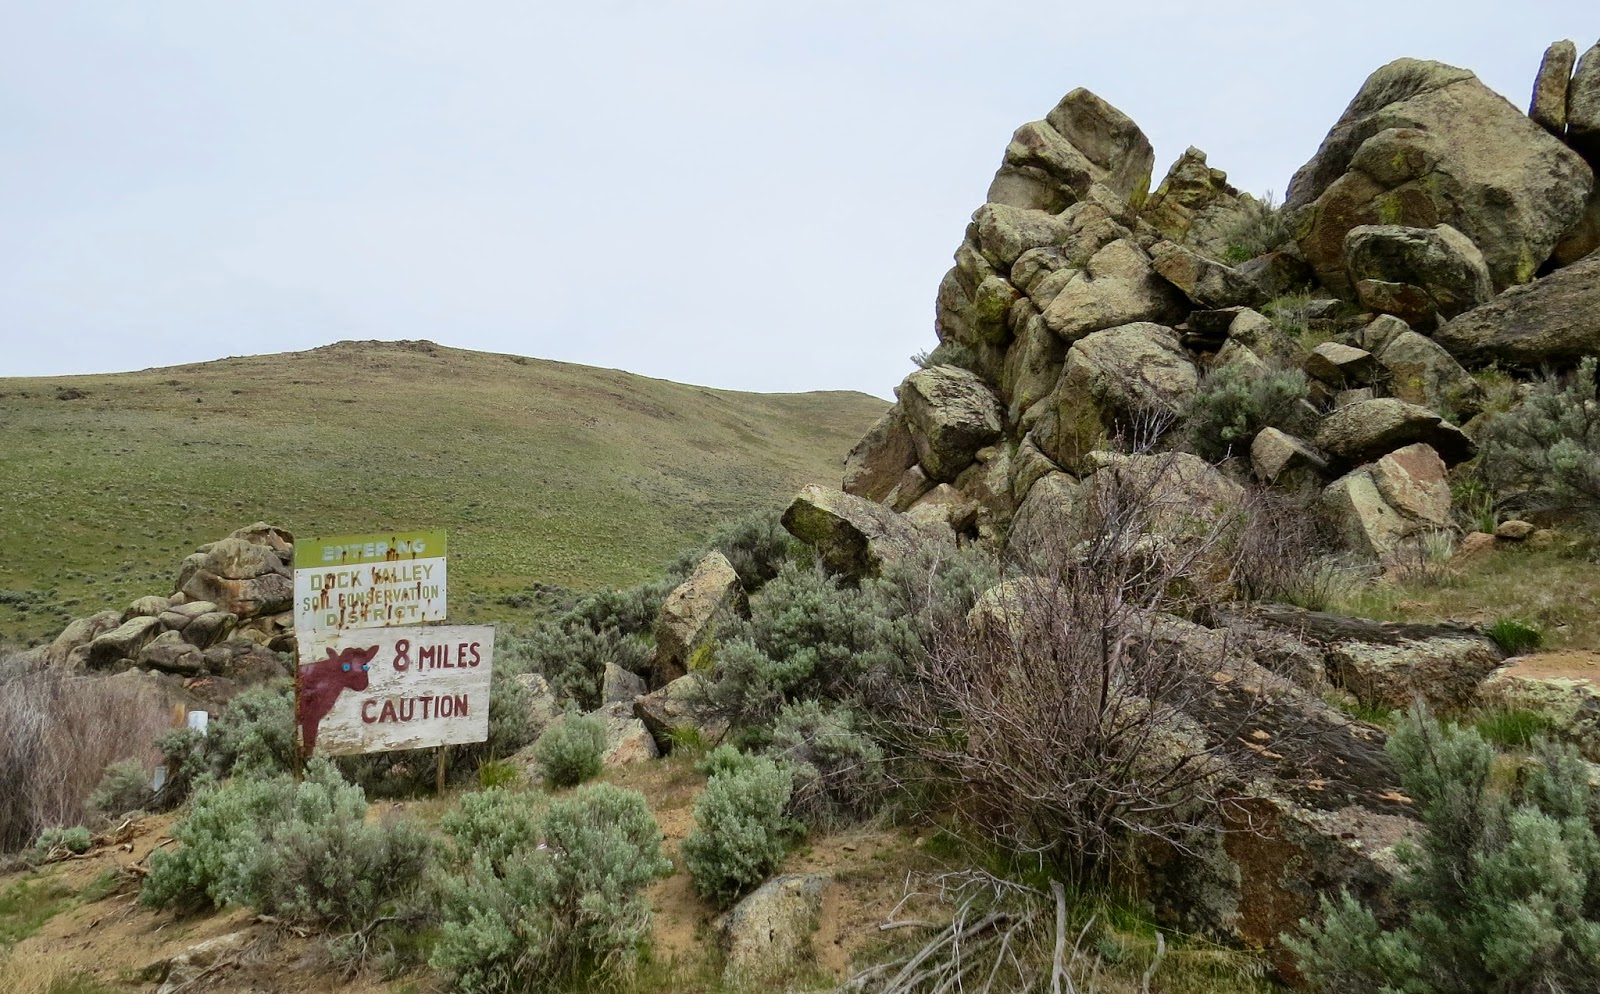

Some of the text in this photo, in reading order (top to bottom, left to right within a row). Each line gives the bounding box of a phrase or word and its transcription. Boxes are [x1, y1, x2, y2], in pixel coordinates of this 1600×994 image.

[321, 538, 426, 561] ENTERNG
[371, 564, 434, 585] VALLEY
[303, 585, 439, 612] SOIL CONSERVATION
[326, 605, 419, 626] DISTRICT
[393, 639, 481, 672] 8 MILES
[361, 693, 468, 724] CAUTION
